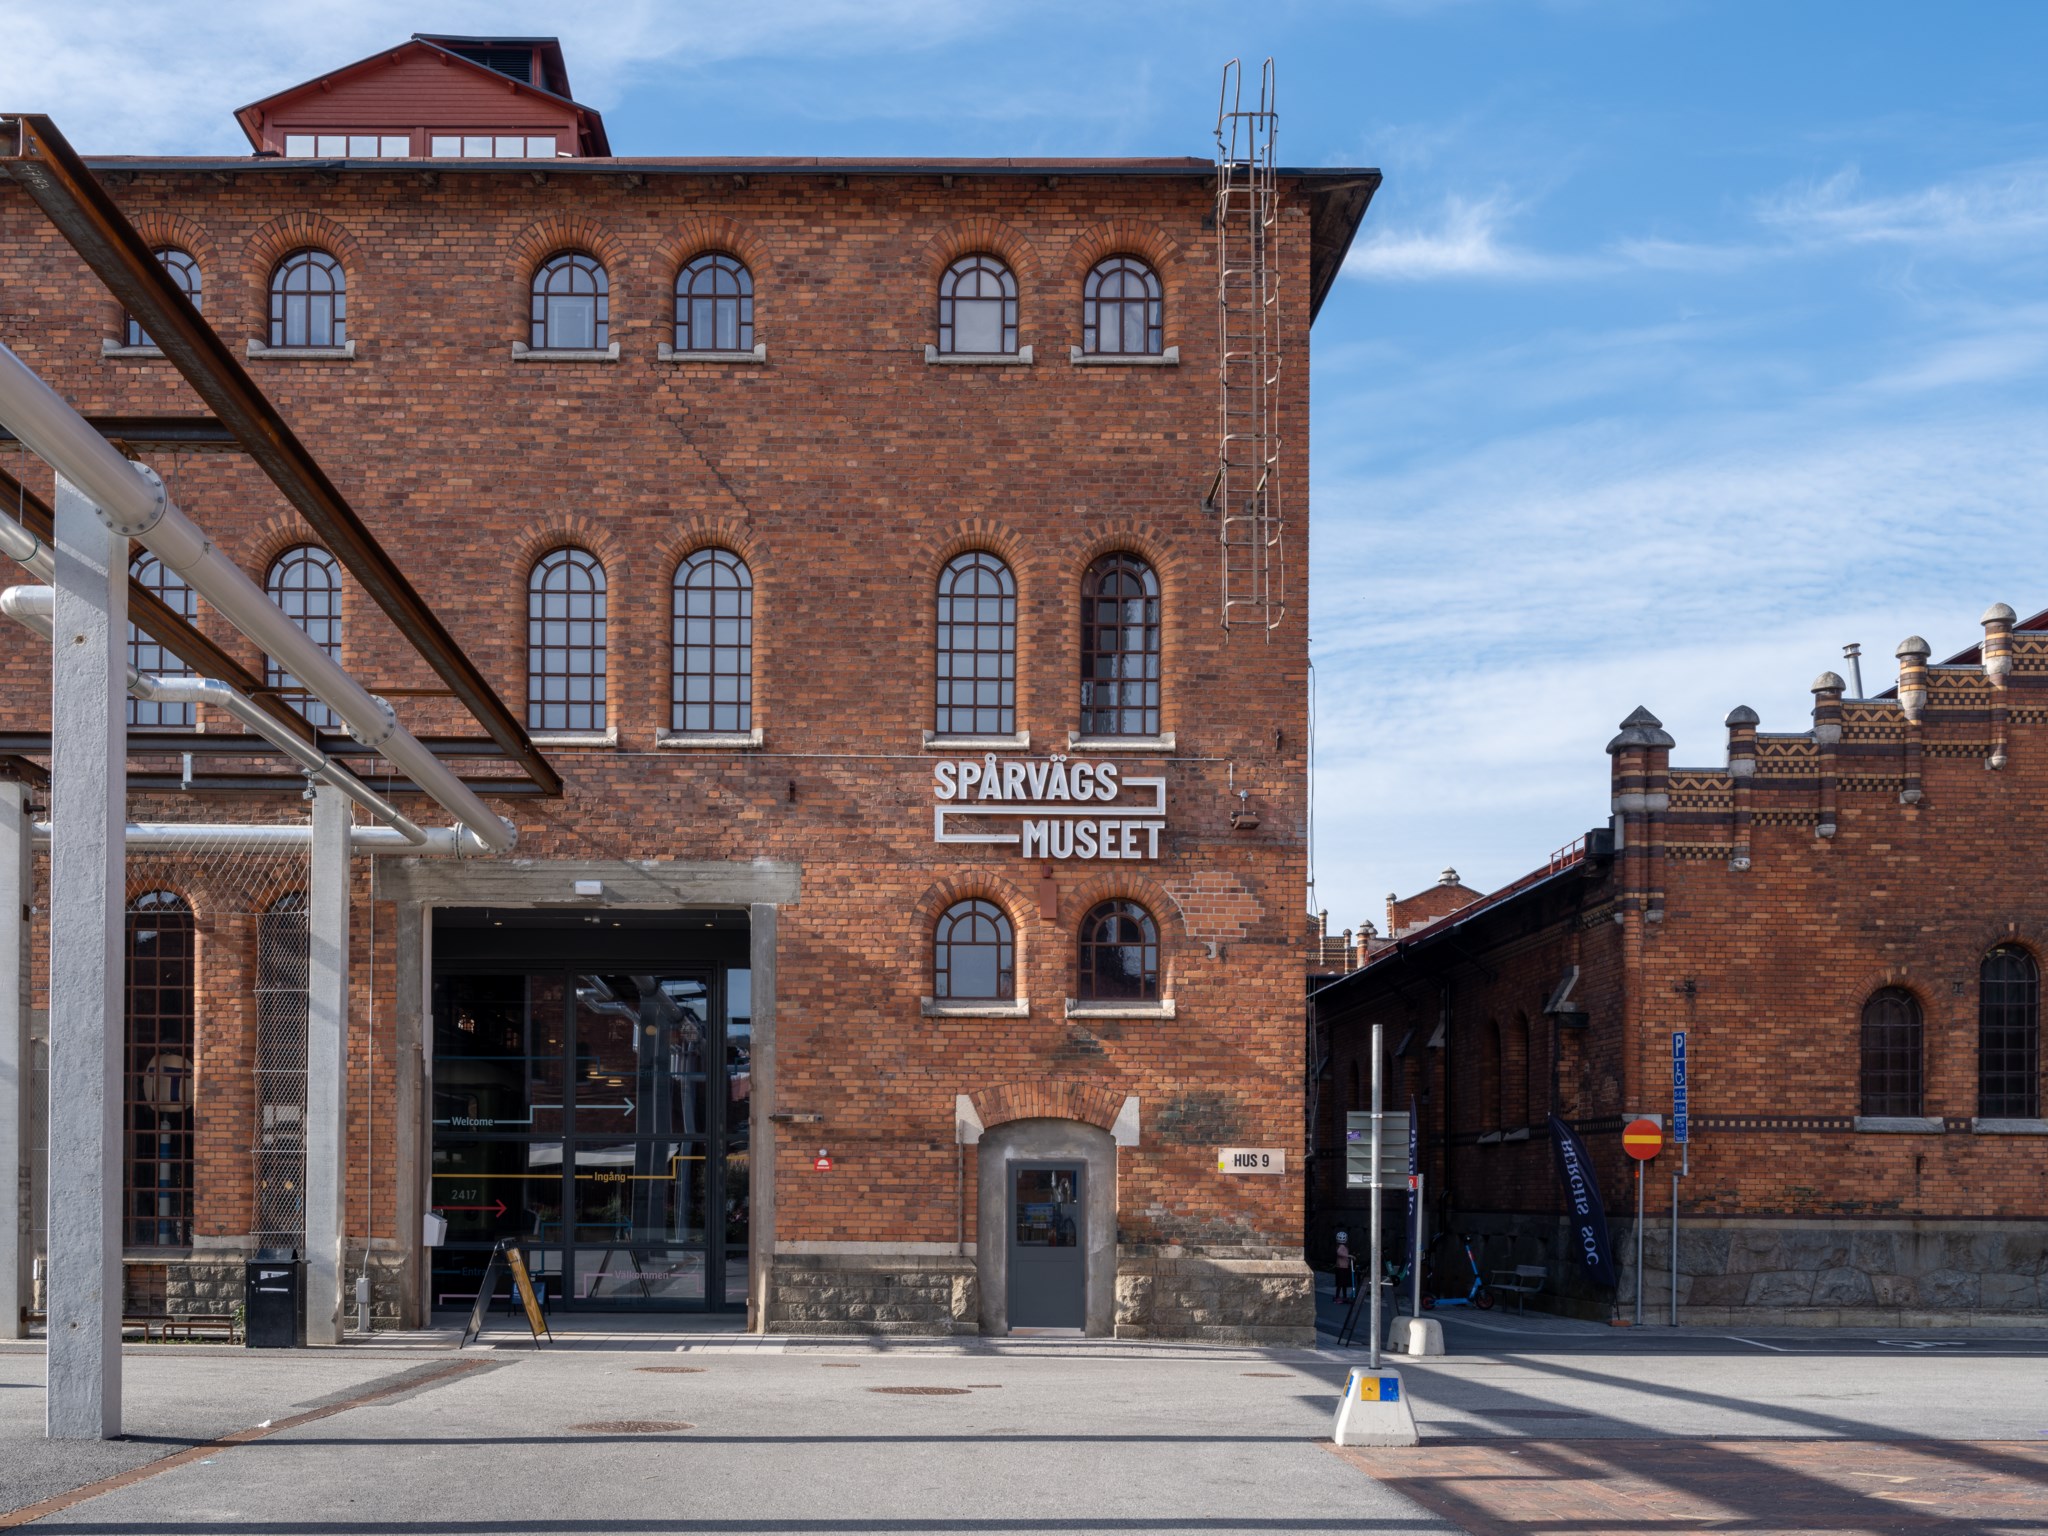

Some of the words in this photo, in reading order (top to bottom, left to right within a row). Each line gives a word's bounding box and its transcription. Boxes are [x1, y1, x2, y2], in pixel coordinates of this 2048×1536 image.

[934, 752, 1118, 800] SPÅRVÄGS
[1023, 820, 1165, 859] MUSEET
[1675, 1035, 1683, 1057] P
[451, 1116, 494, 1126] Welcome
[1234, 1154, 1258, 1168] HUS
[1262, 1154, 1269, 1168] 9
[594, 1171, 626, 1183] Ingång
[451, 1189, 477, 1200] 2417
